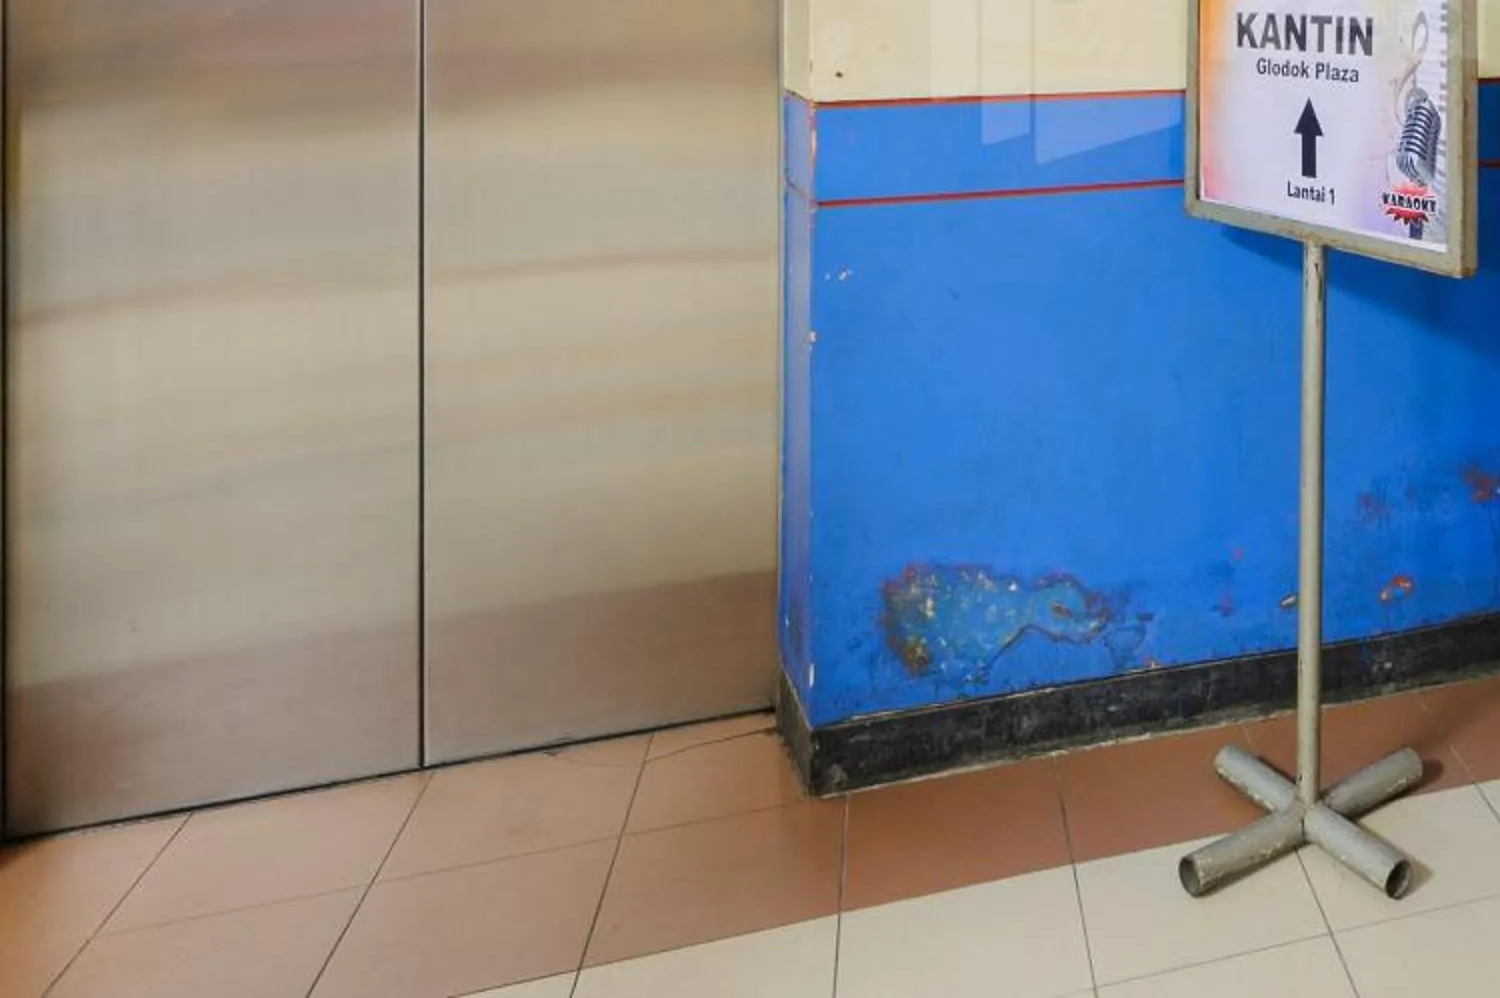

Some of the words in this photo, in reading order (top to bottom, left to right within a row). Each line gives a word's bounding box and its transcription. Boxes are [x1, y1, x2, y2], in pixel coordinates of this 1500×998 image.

[1236, 12, 1373, 57] KANTIN
[1256, 57, 1310, 79] Glodok
[1315, 62, 1360, 83] Plaza
[1286, 179, 1325, 203] Lantai
[1328, 188, 1336, 206] 1
